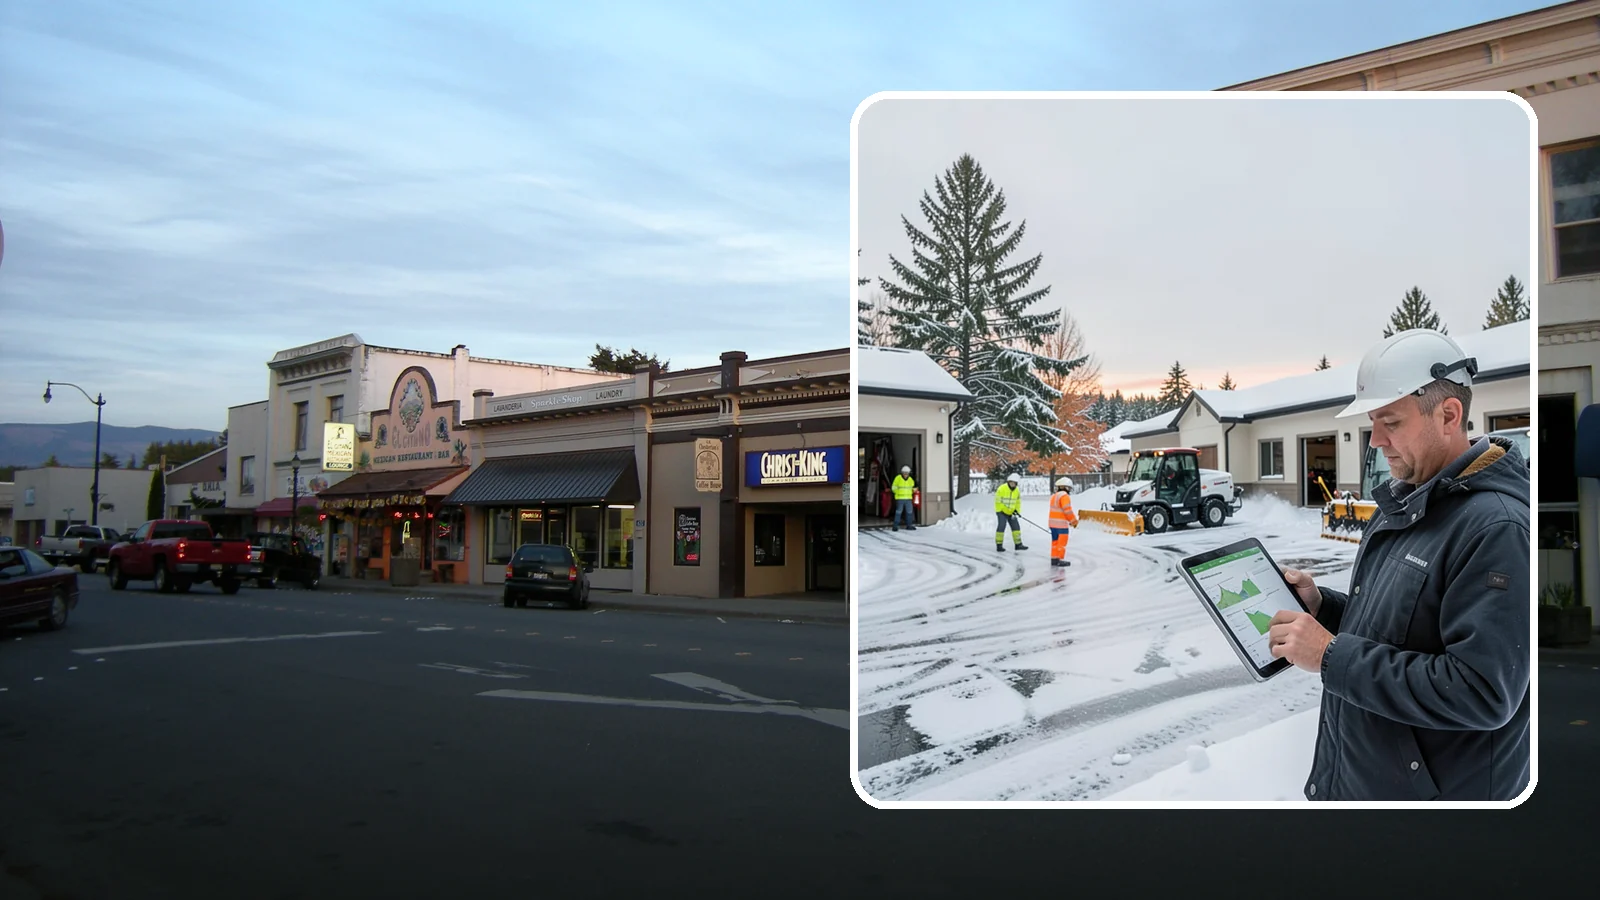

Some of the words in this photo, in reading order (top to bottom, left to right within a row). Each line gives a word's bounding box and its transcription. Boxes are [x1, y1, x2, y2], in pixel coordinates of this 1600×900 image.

[595, 389, 624, 400] LAUNDRY
[494, 402, 522, 412] LAVANDERIA
[531, 396, 560, 409] Sparkle
[562, 394, 582, 406] Shop
[373, 455, 396, 463] MEXICAN
[397, 451, 433, 462] RESTAURANT
[437, 450, 450, 459] BAR
[761, 452, 797, 478] CHRIST
[799, 450, 827, 476] KING
